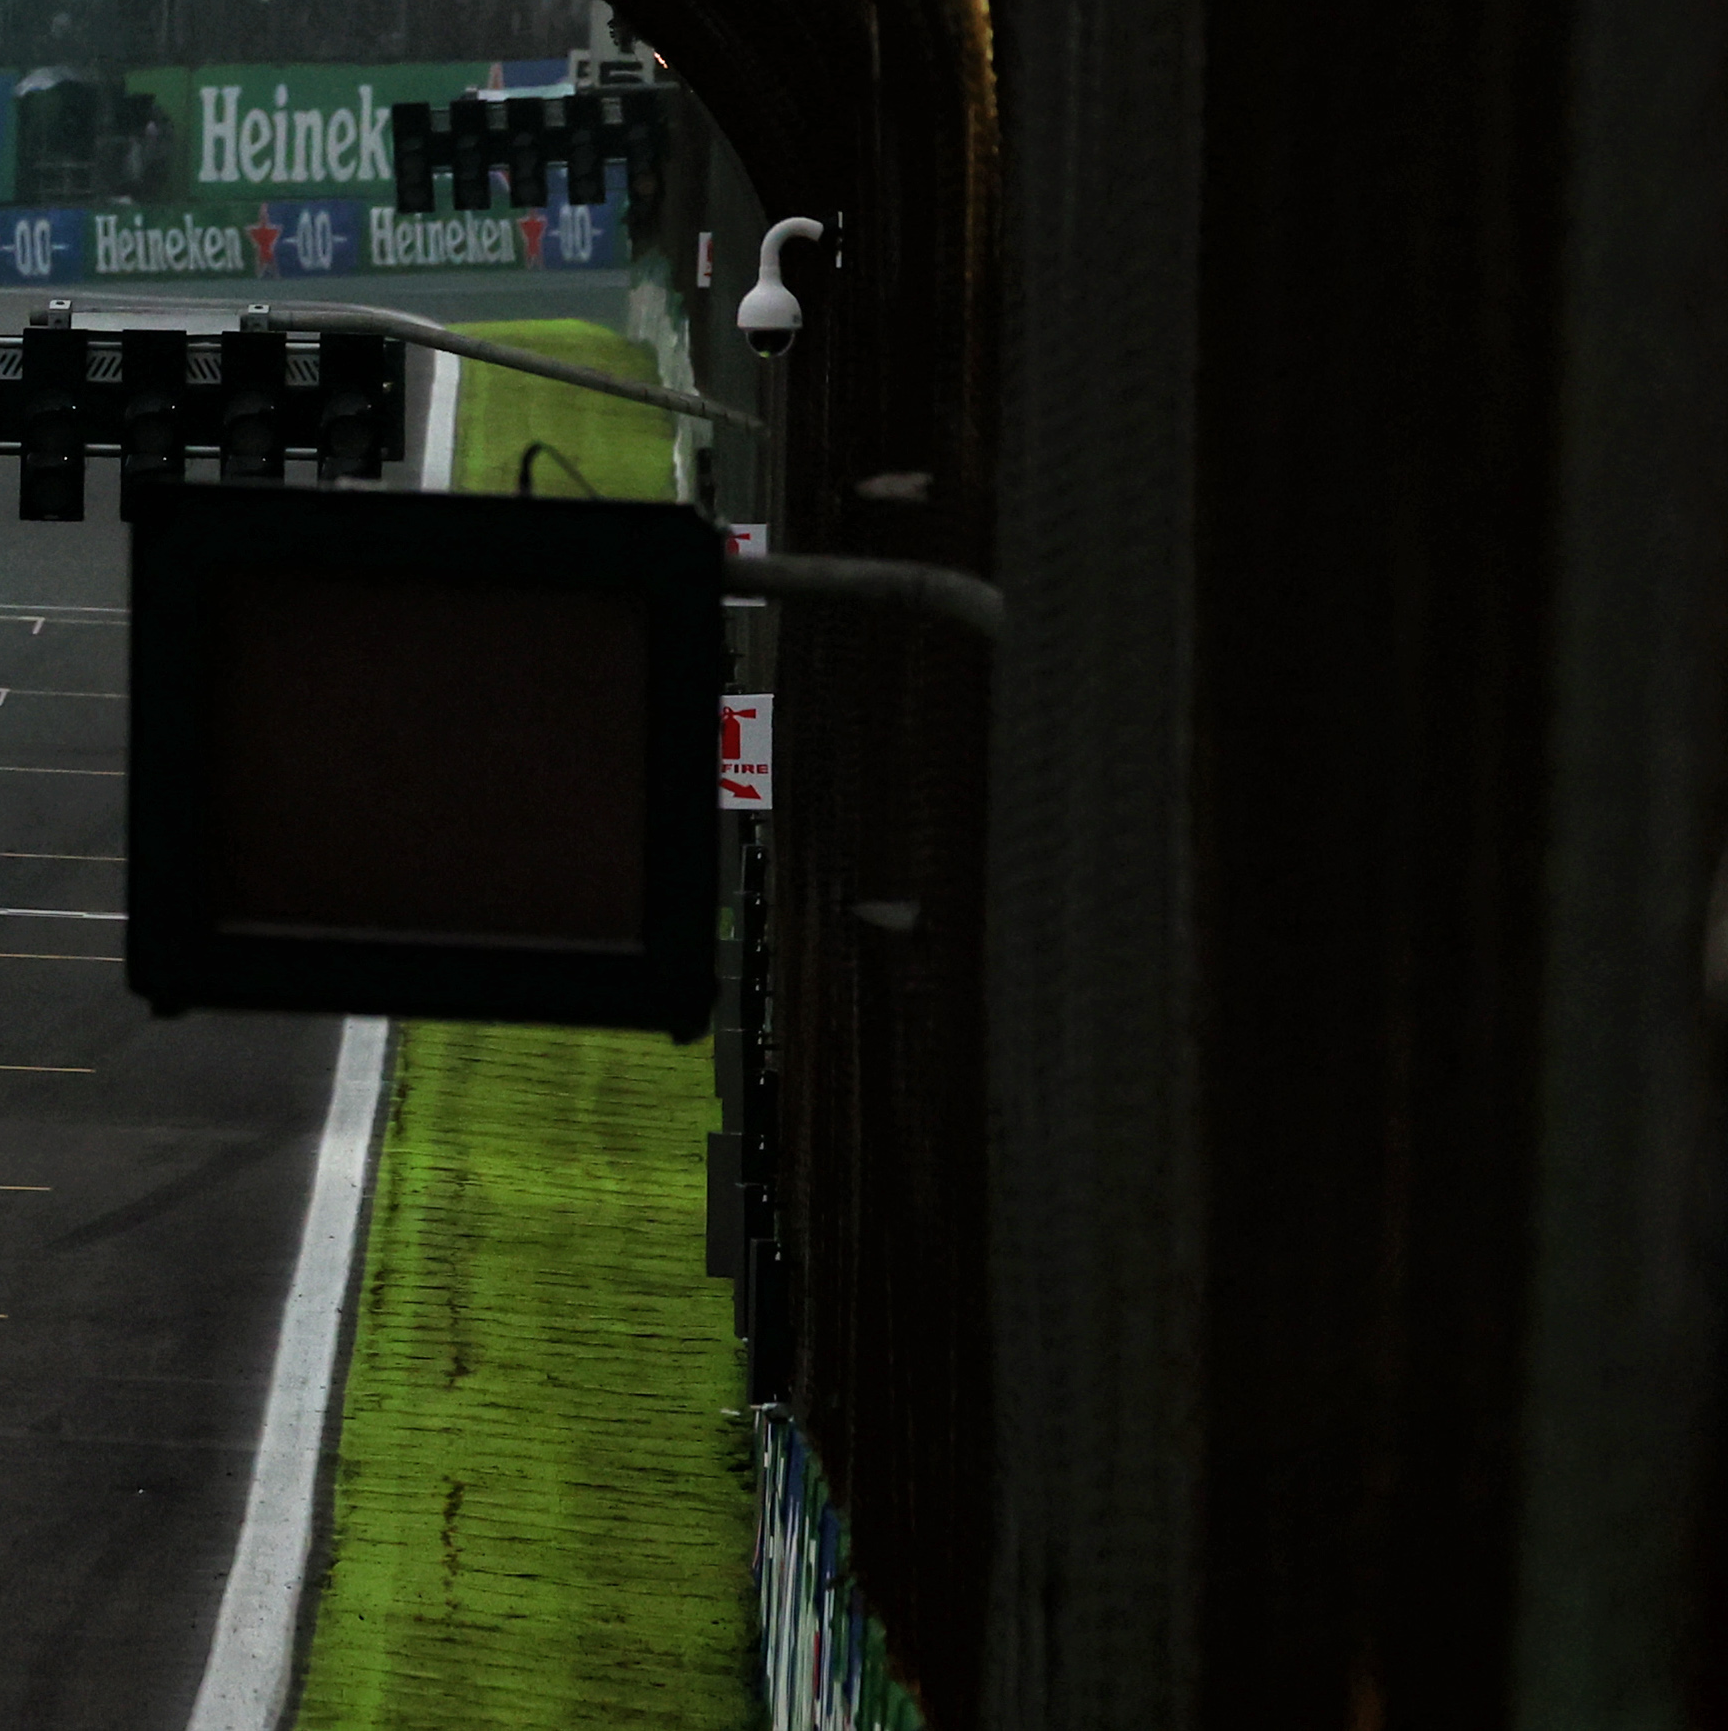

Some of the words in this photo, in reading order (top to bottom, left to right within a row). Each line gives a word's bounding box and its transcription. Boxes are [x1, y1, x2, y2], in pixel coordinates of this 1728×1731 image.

[198, 83, 454, 184] Heinek
[94, 212, 244, 274] Heineken
[369, 206, 518, 268] Heineken
[721, 763, 769, 775] FIRE
